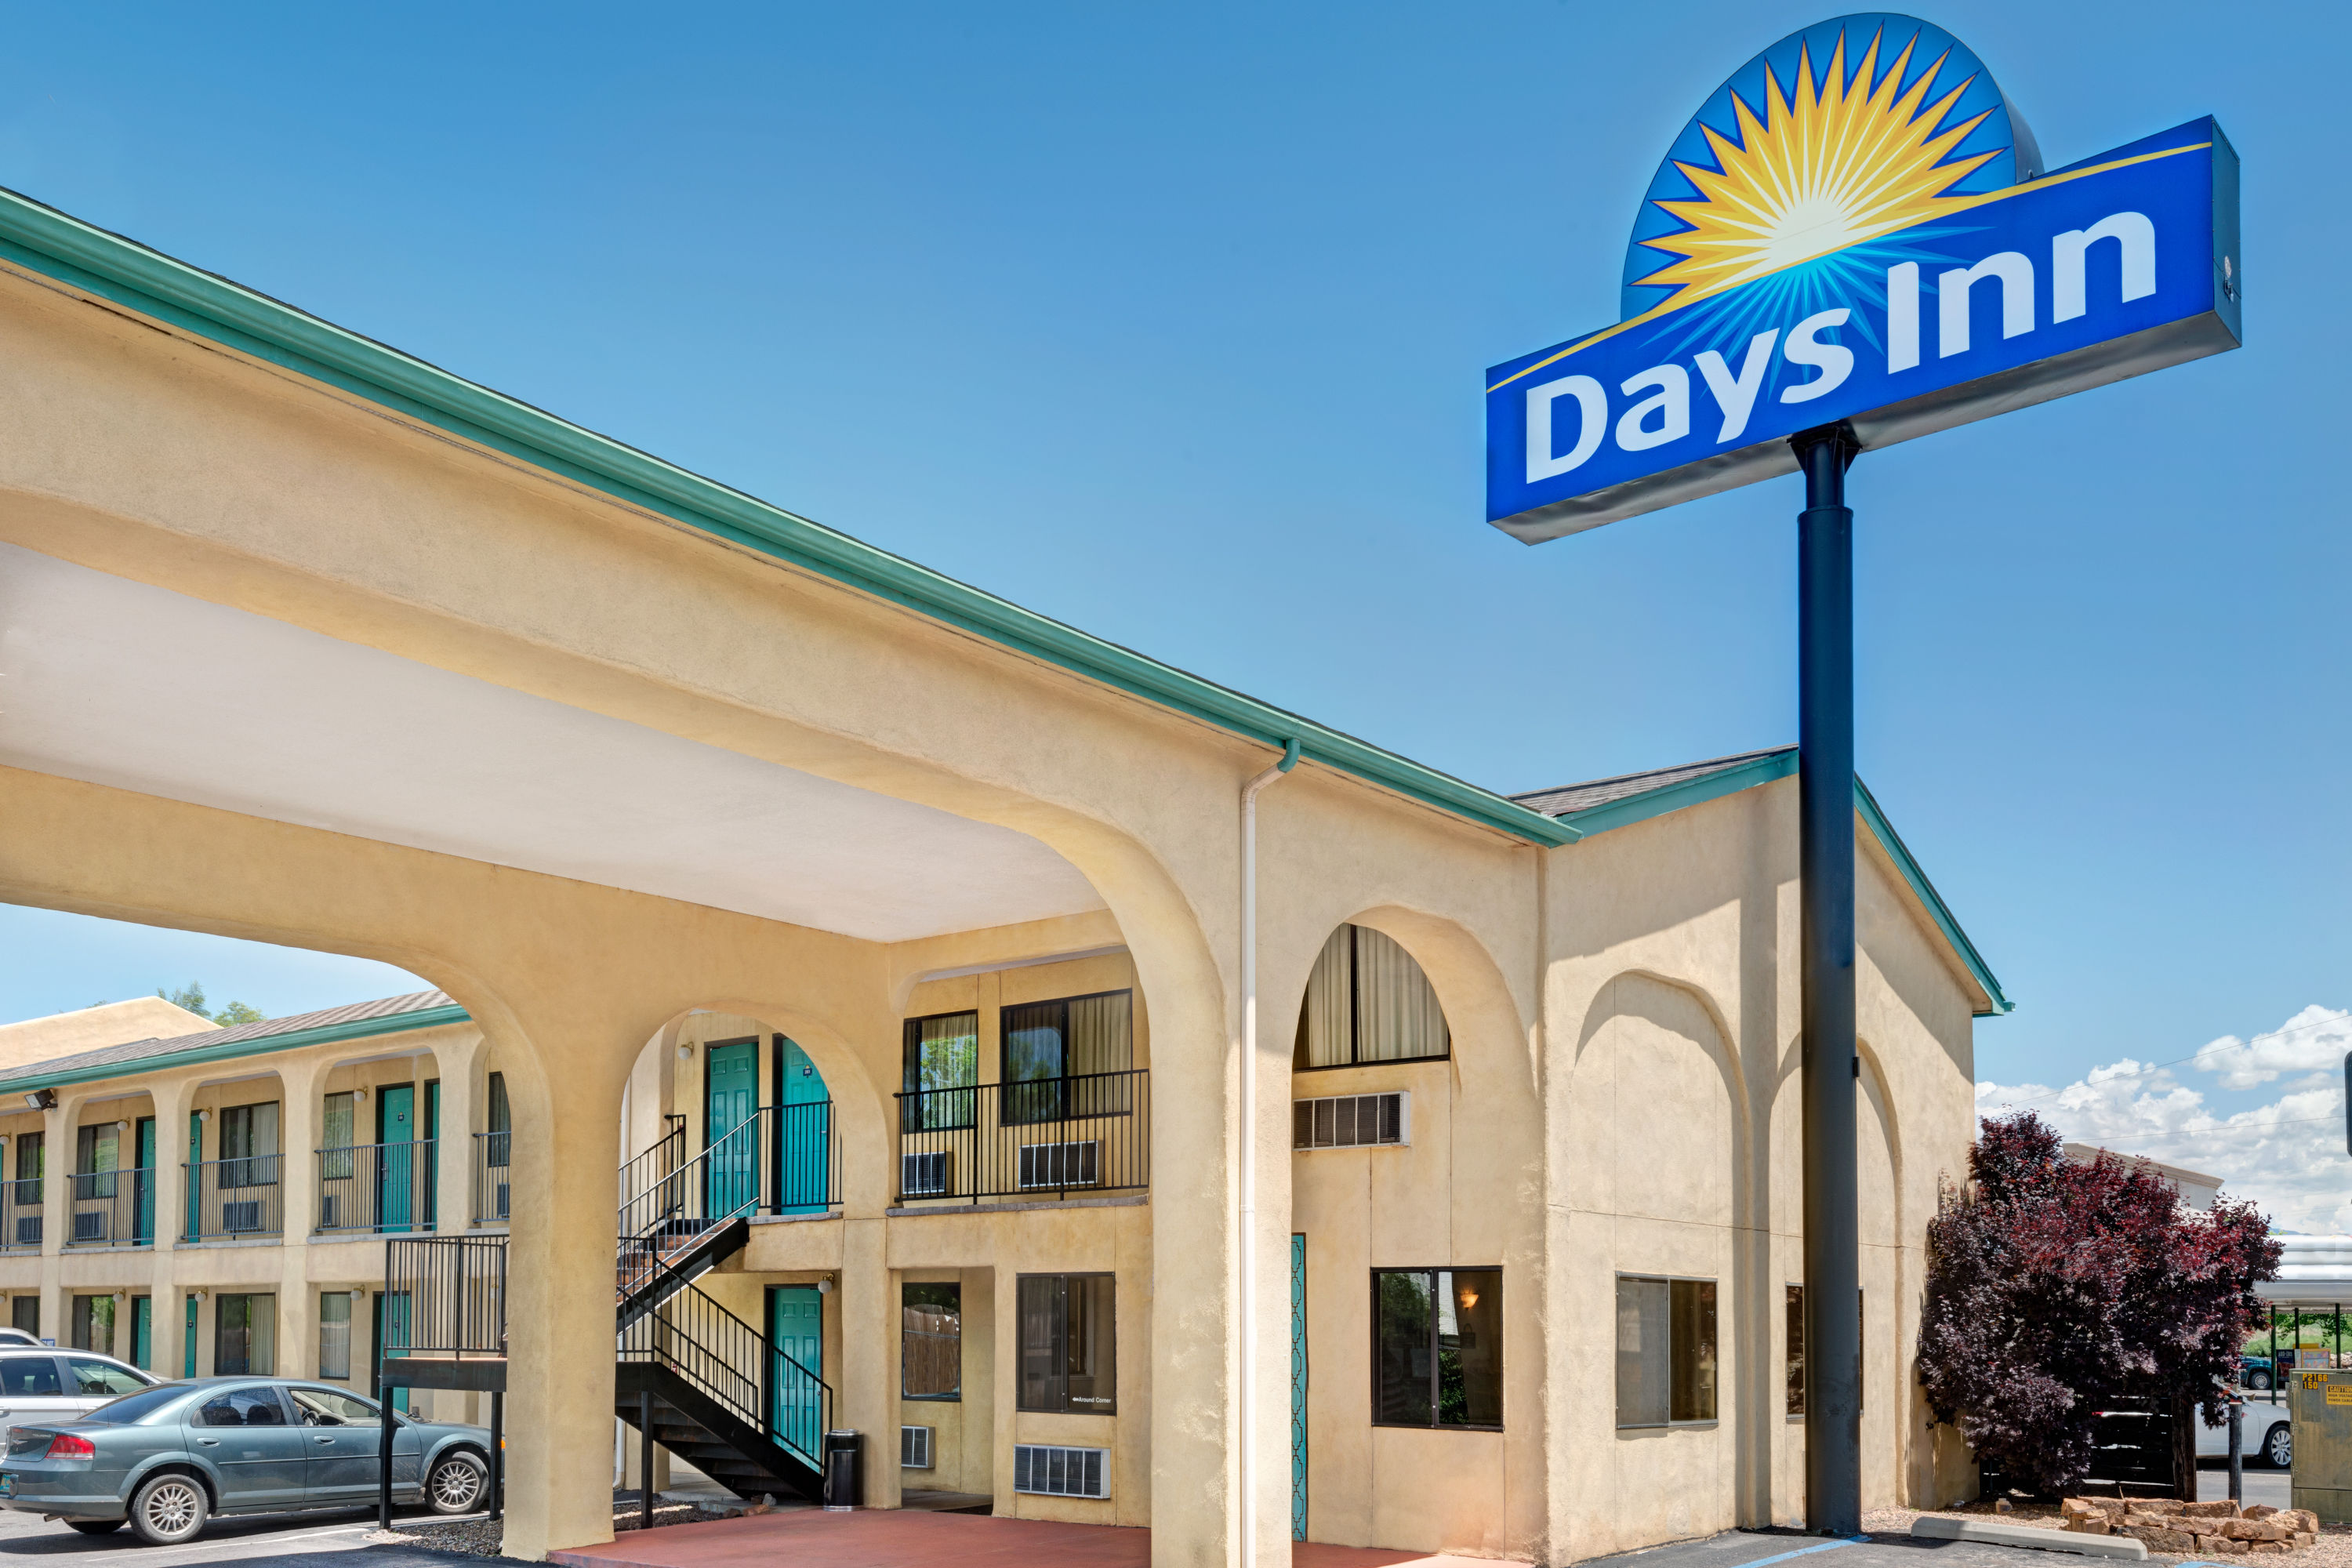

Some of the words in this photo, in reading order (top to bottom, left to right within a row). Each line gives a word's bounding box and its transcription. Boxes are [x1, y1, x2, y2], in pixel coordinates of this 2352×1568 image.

[1526, 308, 1854, 484] Days
[1887, 212, 2156, 374] Inn
[2303, 1374, 2328, 1382] P2166
